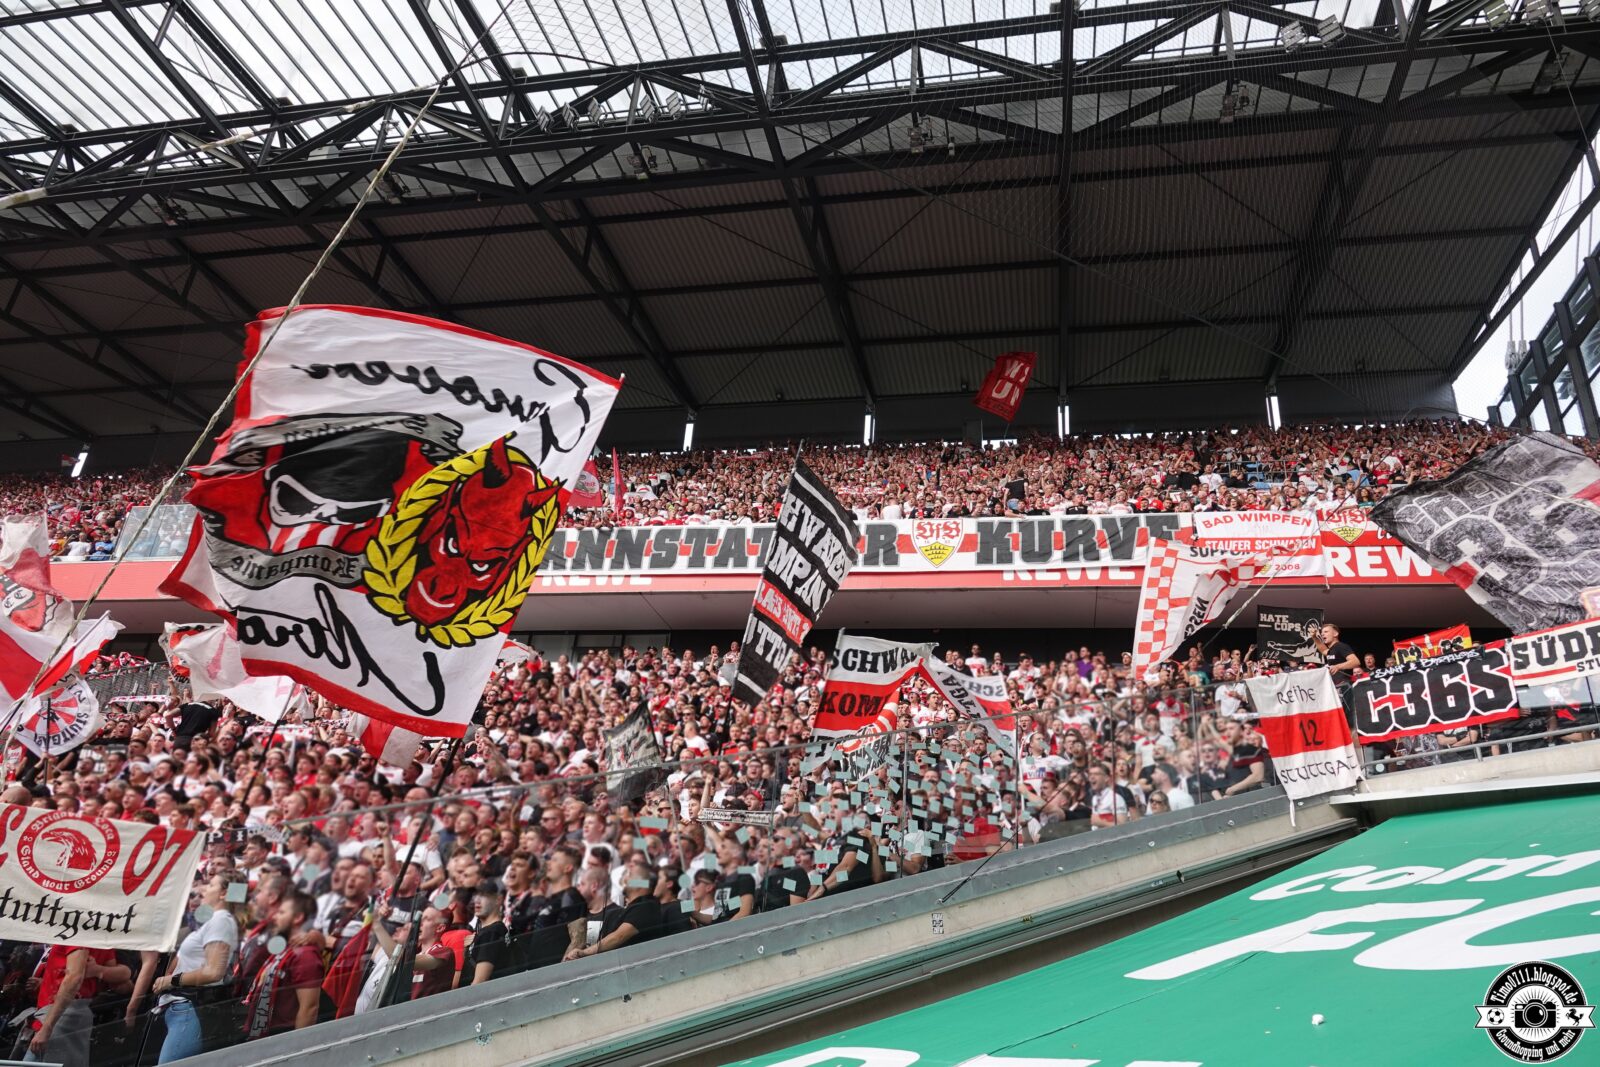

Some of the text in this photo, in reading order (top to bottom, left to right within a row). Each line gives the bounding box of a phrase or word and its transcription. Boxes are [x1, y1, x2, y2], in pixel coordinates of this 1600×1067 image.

[1202, 513, 1313, 529] BAD WIMPFEN
[1205, 540, 1251, 551] STAUFER
[1274, 563, 1301, 571] 2008
[1323, 545, 1433, 578] REW
[1259, 613, 1290, 623] HATE
[1273, 622, 1301, 632] COPS
[1299, 719, 1324, 746] 12
[121, 824, 198, 897] 07
